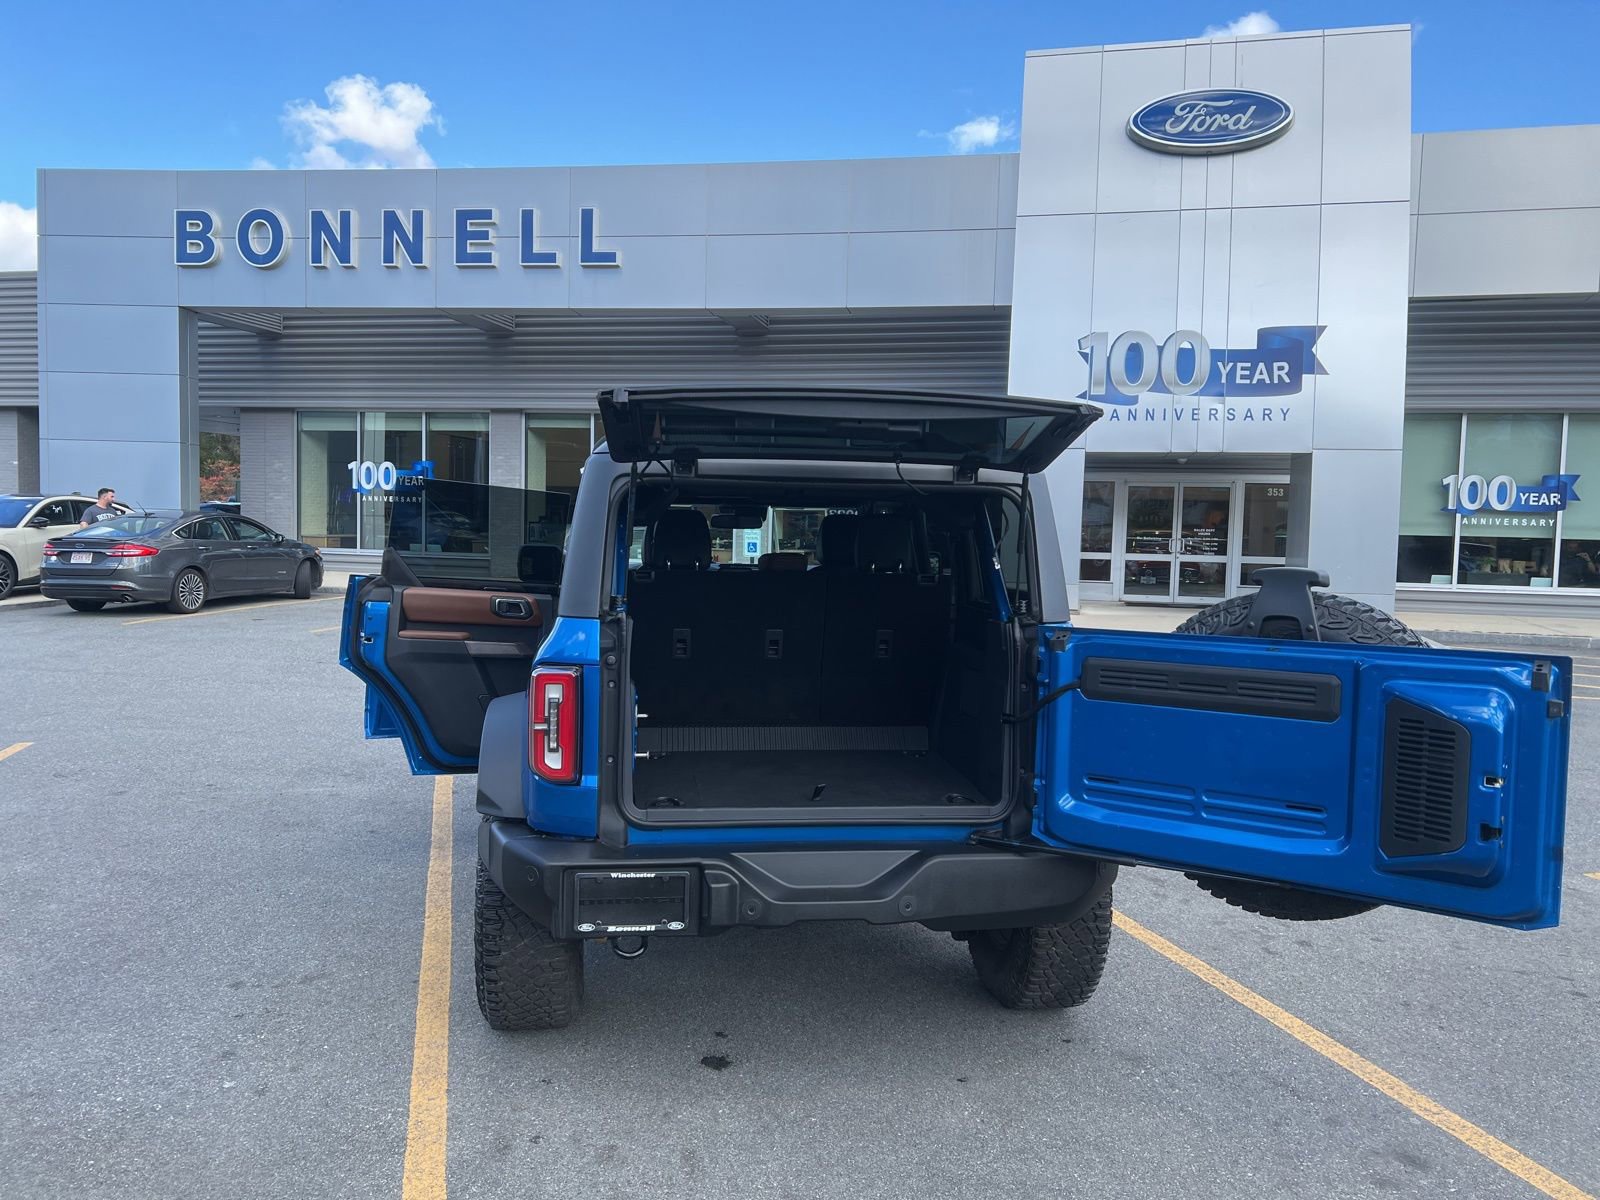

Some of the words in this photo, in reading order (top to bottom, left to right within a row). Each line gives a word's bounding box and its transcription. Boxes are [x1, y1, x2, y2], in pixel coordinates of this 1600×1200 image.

[1165, 99, 1256, 134] Ford
[174, 208, 621, 269] BONNELL
[1077, 330, 1210, 396] 100
[1217, 361, 1291, 385] YEAR
[1109, 407, 1291, 422] ANNIVERSARY
[347, 460, 397, 490] 100
[398, 475, 424, 486] YEAR
[362, 495, 422, 503] ANNIVERSARY
[1266, 487, 1284, 497] 353
[1441, 474, 1517, 511] 100
[1519, 492, 1561, 506] YEAR
[96, 513, 115, 521] BOST
[1462, 517, 1555, 527] ANNIVERSARY
